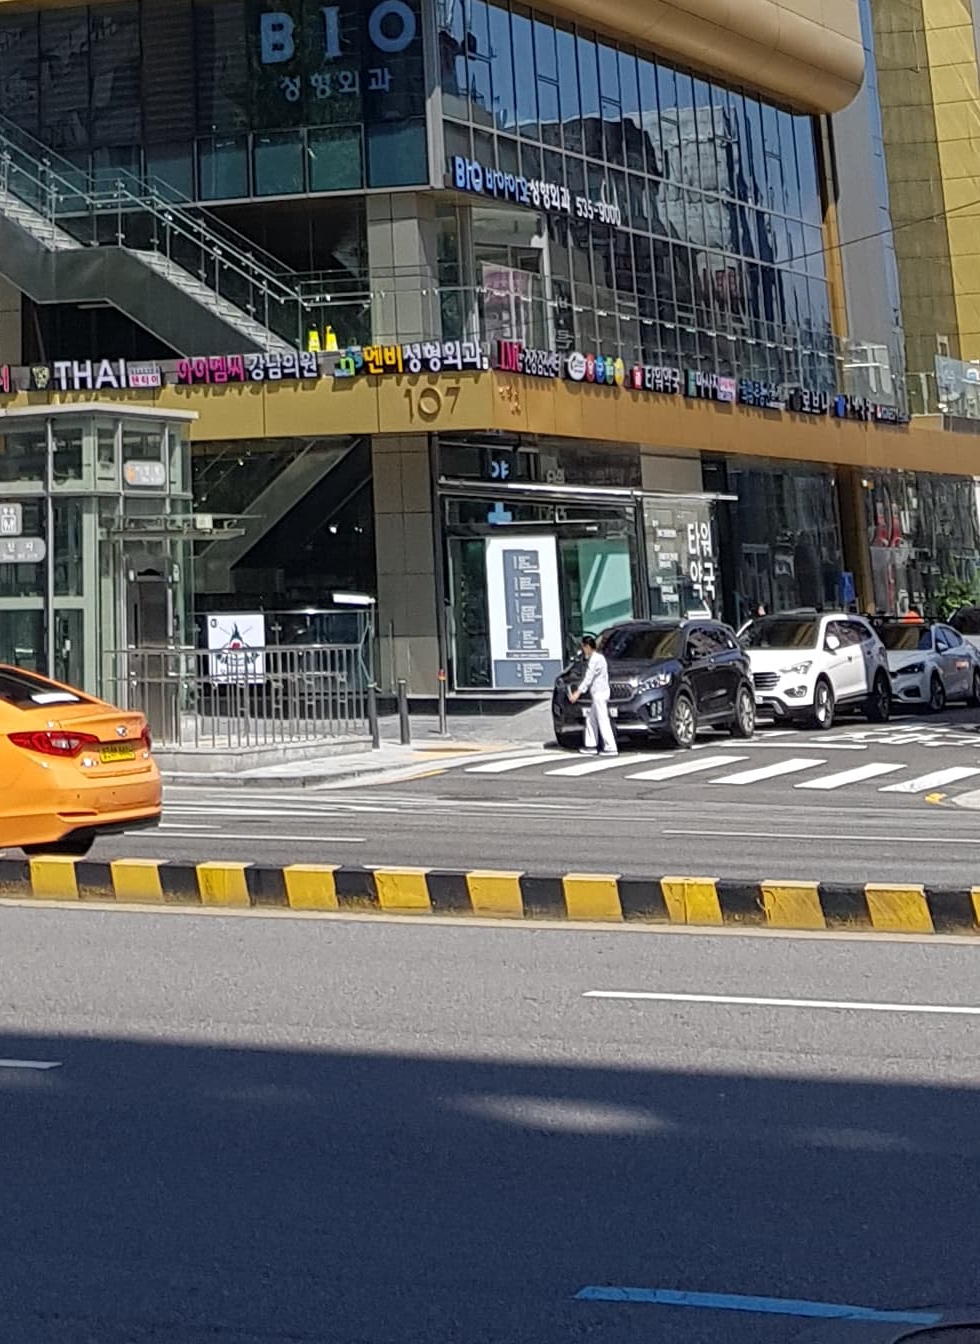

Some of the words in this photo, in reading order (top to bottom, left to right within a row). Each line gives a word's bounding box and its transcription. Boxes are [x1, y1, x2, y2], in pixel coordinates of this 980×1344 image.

[260, 0, 416, 64] BIO
[280, 67, 393, 102] 성형외과
[454, 155, 483, 192] BIO
[575, 195, 621, 226] 535-9000
[54, 358, 127, 391] THAI
[248, 351, 318, 381] 강남의원
[403, 386, 461, 424] 107
